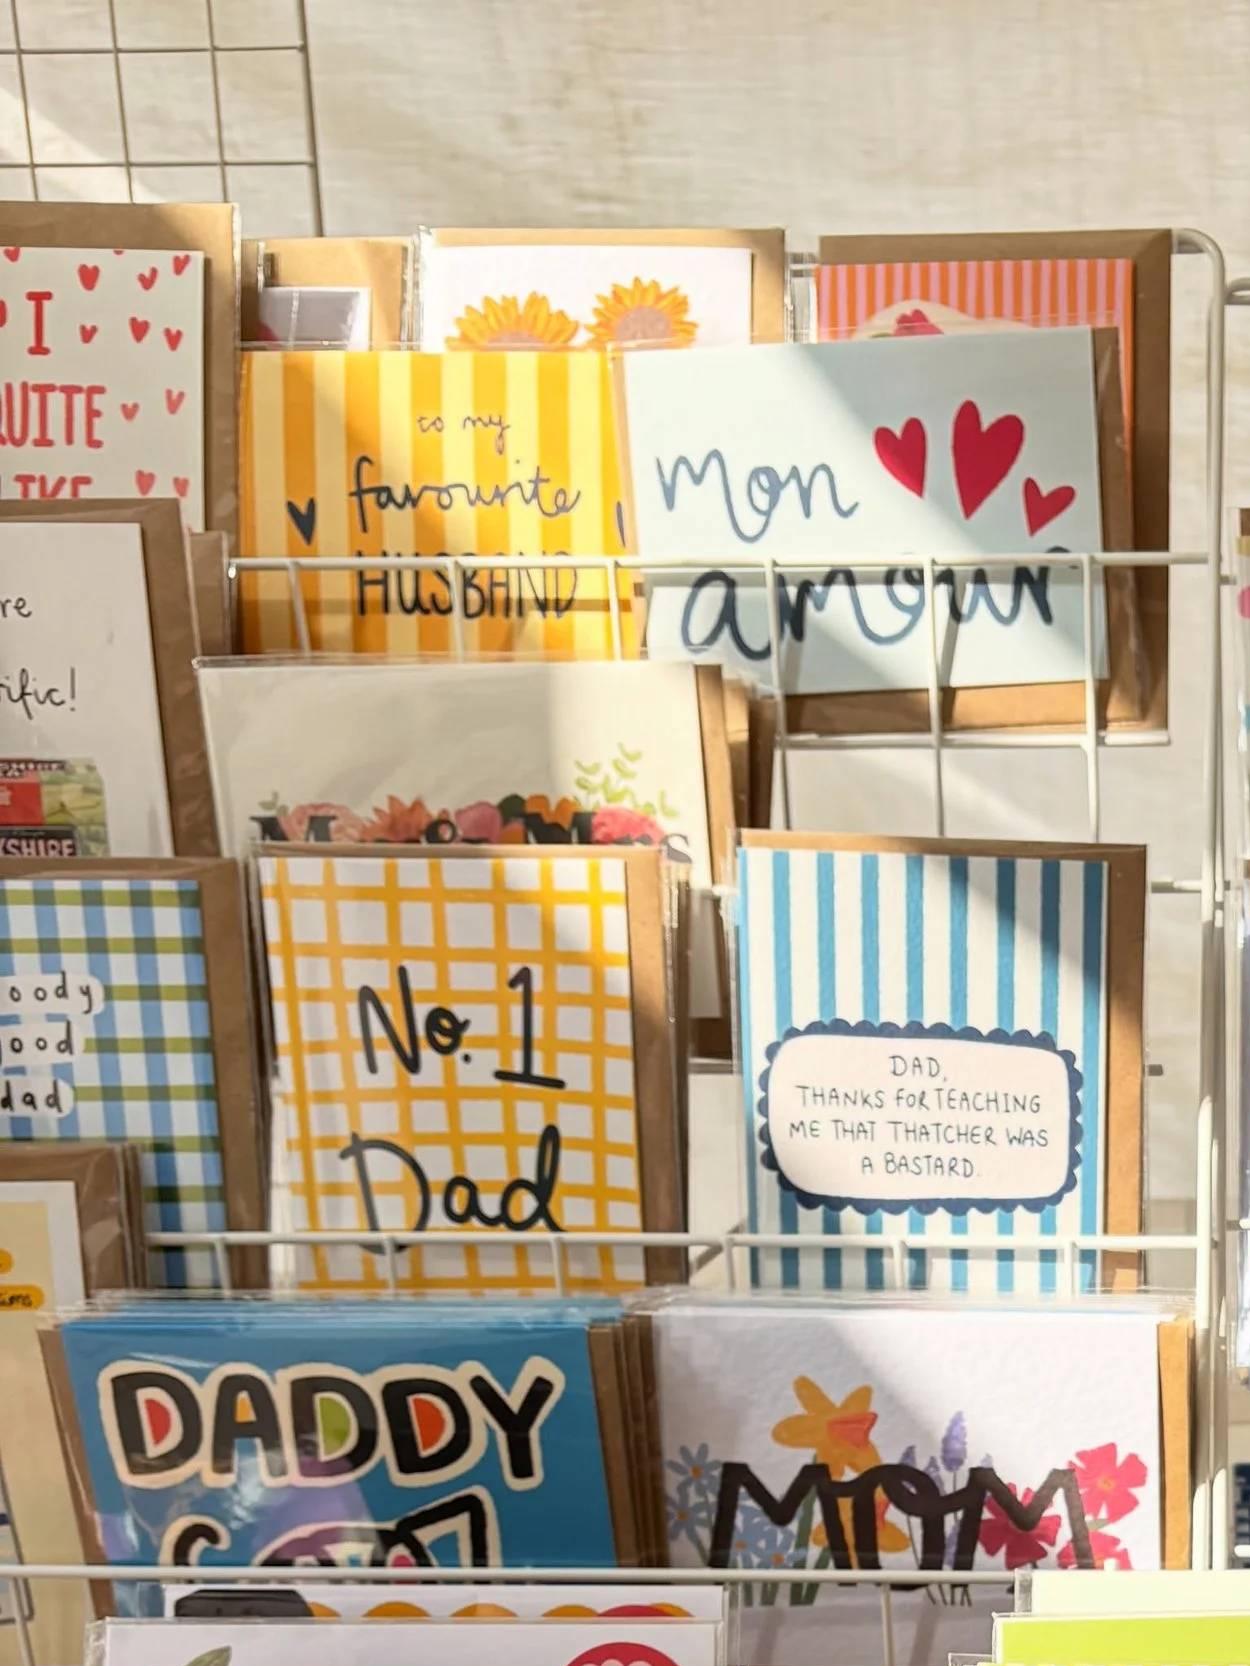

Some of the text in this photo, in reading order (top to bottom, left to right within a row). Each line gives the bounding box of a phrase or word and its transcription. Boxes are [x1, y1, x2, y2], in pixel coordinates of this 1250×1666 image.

[25, 291, 53, 356] I
[0, 381, 107, 449] UITE
[417, 414, 510, 455] to my
[348, 455, 581, 534] favourite
[355, 551, 578, 619] HUSBAND
[0, 838, 76, 858] SHIRE
[0, 1019, 74, 1064] ood
[356, 966, 567, 1090] No. 1
[888, 1055, 947, 1082] DAD,
[795, 1085, 1041, 1114] THANKS FOR TEACHING
[789, 1120, 1049, 1148] ME THAT THATCHER WAS
[338, 1124, 566, 1256] Dad
[861, 1151, 981, 1179] A BASTARD.
[98, 1356, 565, 1490] DADDY
